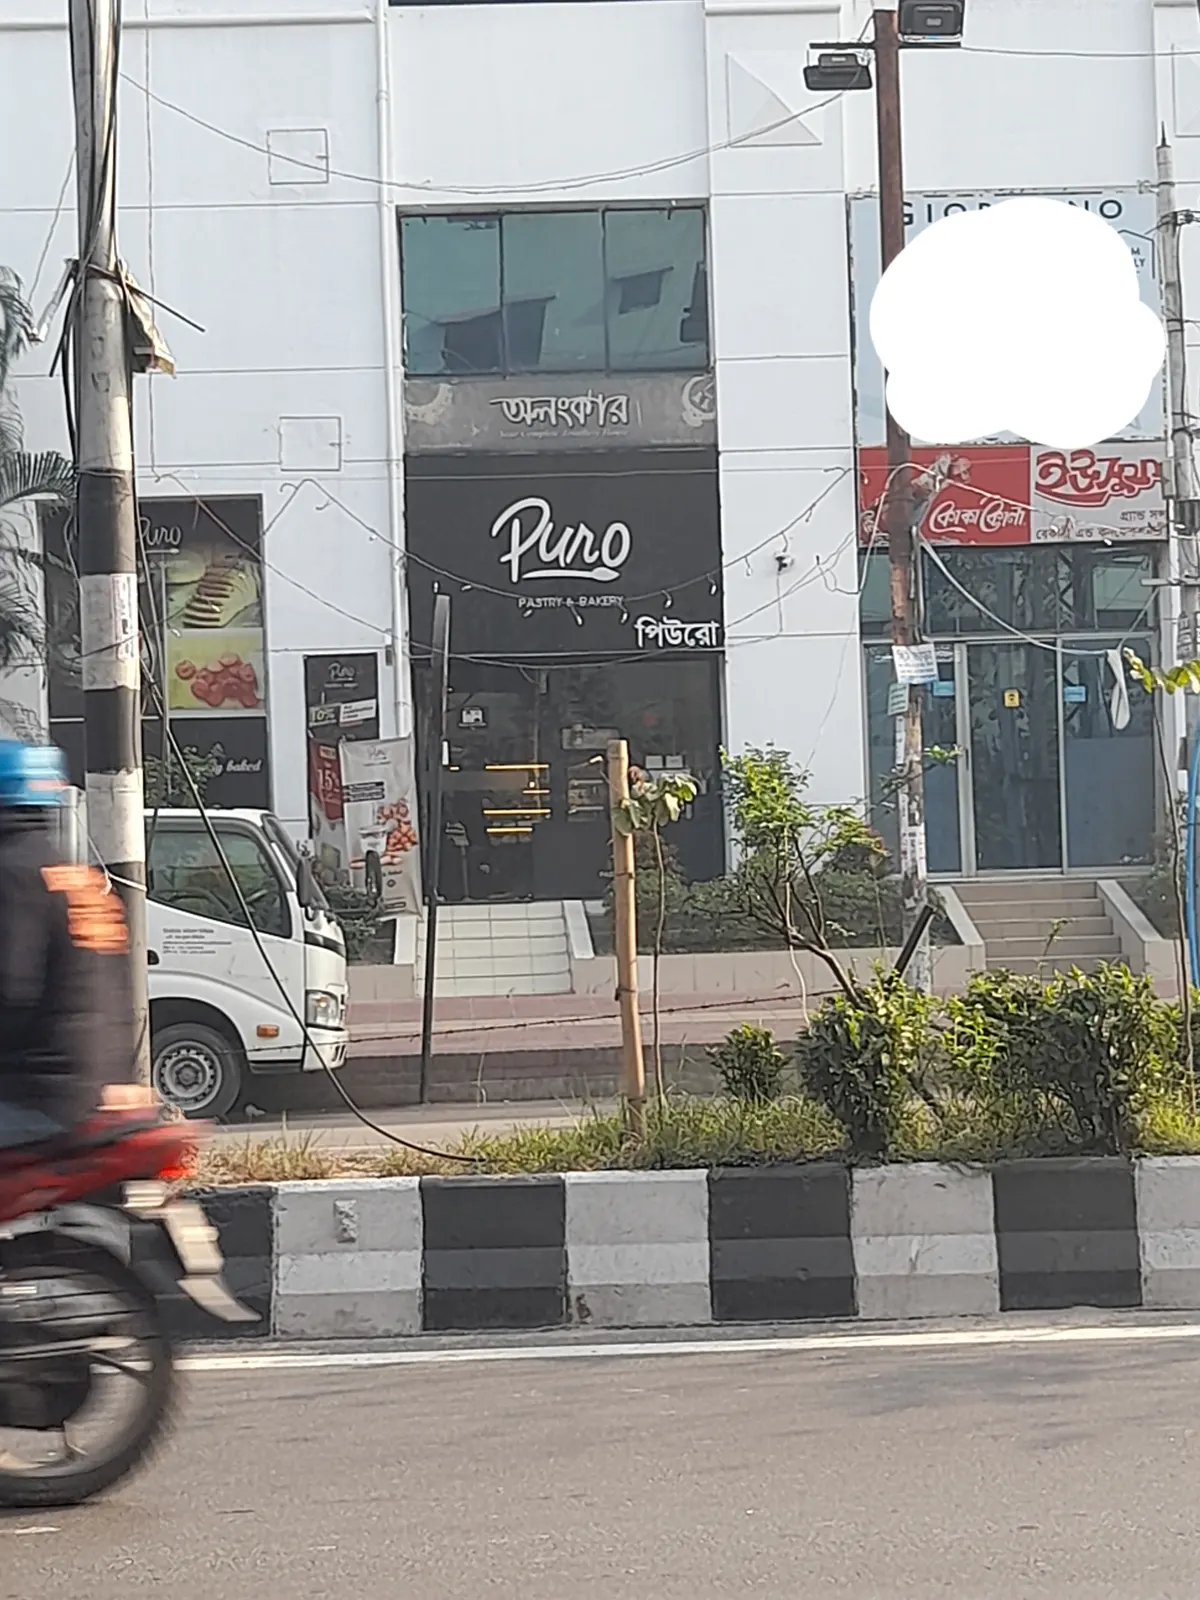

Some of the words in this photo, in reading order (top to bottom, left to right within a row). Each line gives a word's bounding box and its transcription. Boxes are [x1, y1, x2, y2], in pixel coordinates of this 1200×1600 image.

[489, 389, 628, 427] অলংকার
[491, 497, 631, 583] Puro
[518, 597, 562, 608] PASTRY
[579, 595, 624, 607] BAKERY
[634, 615, 719, 648] পিউরো
